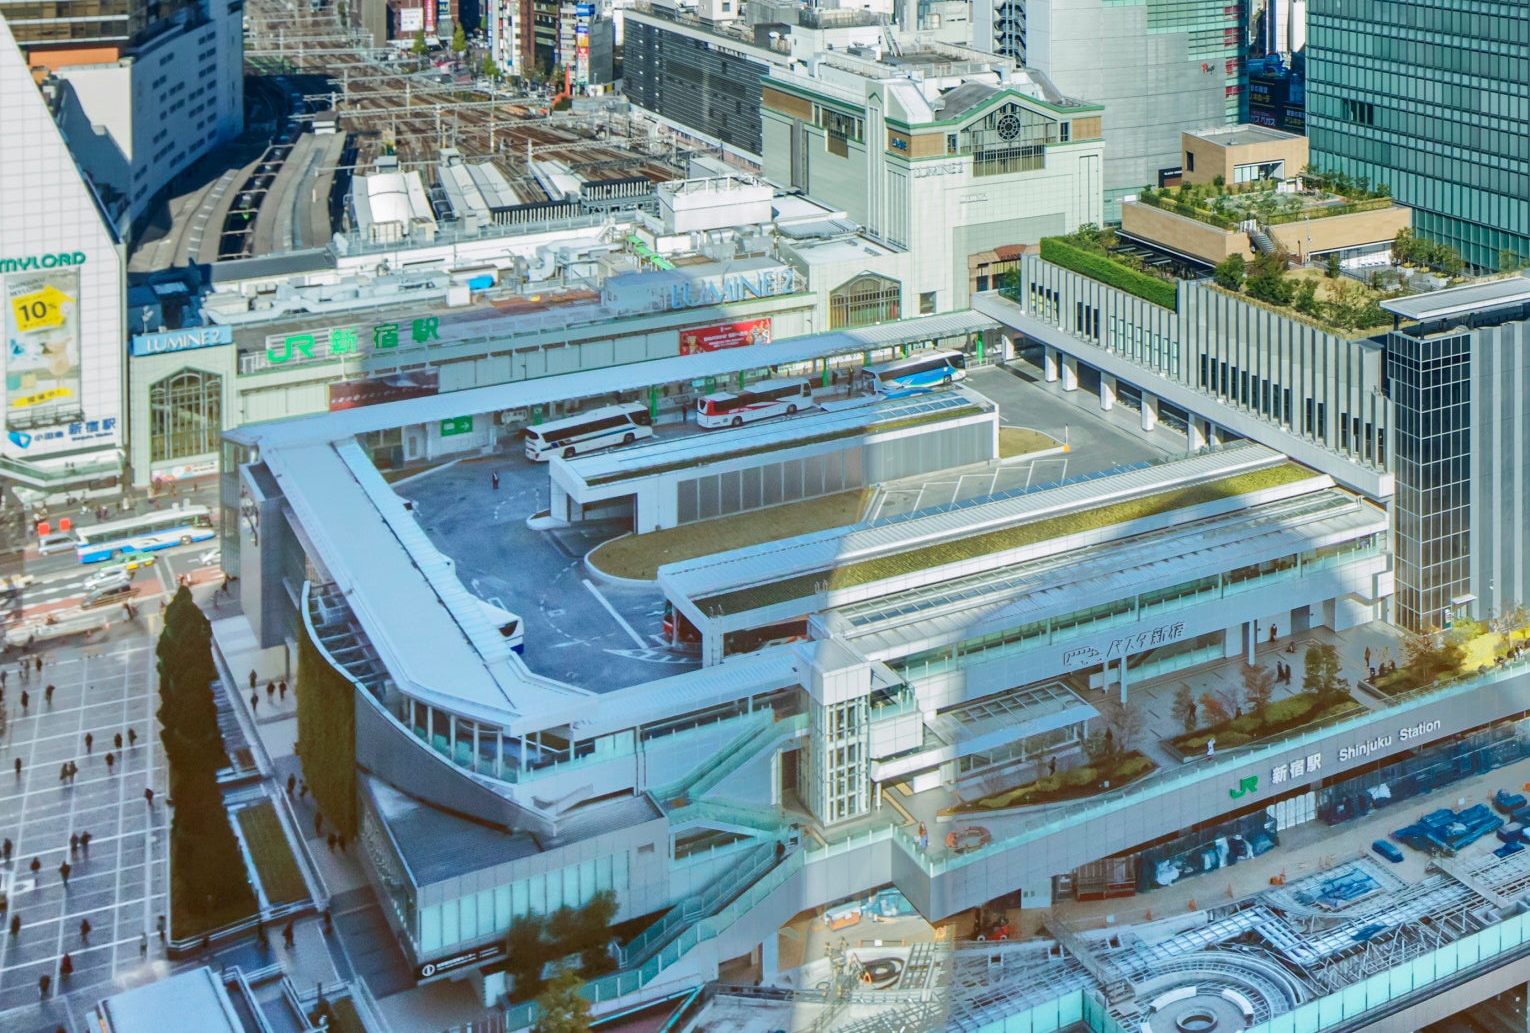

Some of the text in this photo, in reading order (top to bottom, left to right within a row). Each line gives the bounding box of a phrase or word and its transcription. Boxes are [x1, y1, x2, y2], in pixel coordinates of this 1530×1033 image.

[672, 268, 794, 309] LUMINE 2
[146, 329, 221, 352] LUMINE 2
[268, 316, 441, 363] JR 新宿駅
[68, 417, 117, 435] 新宿駅
[1230, 720, 1441, 799] JR 新宿駅 Shinjuku Station
